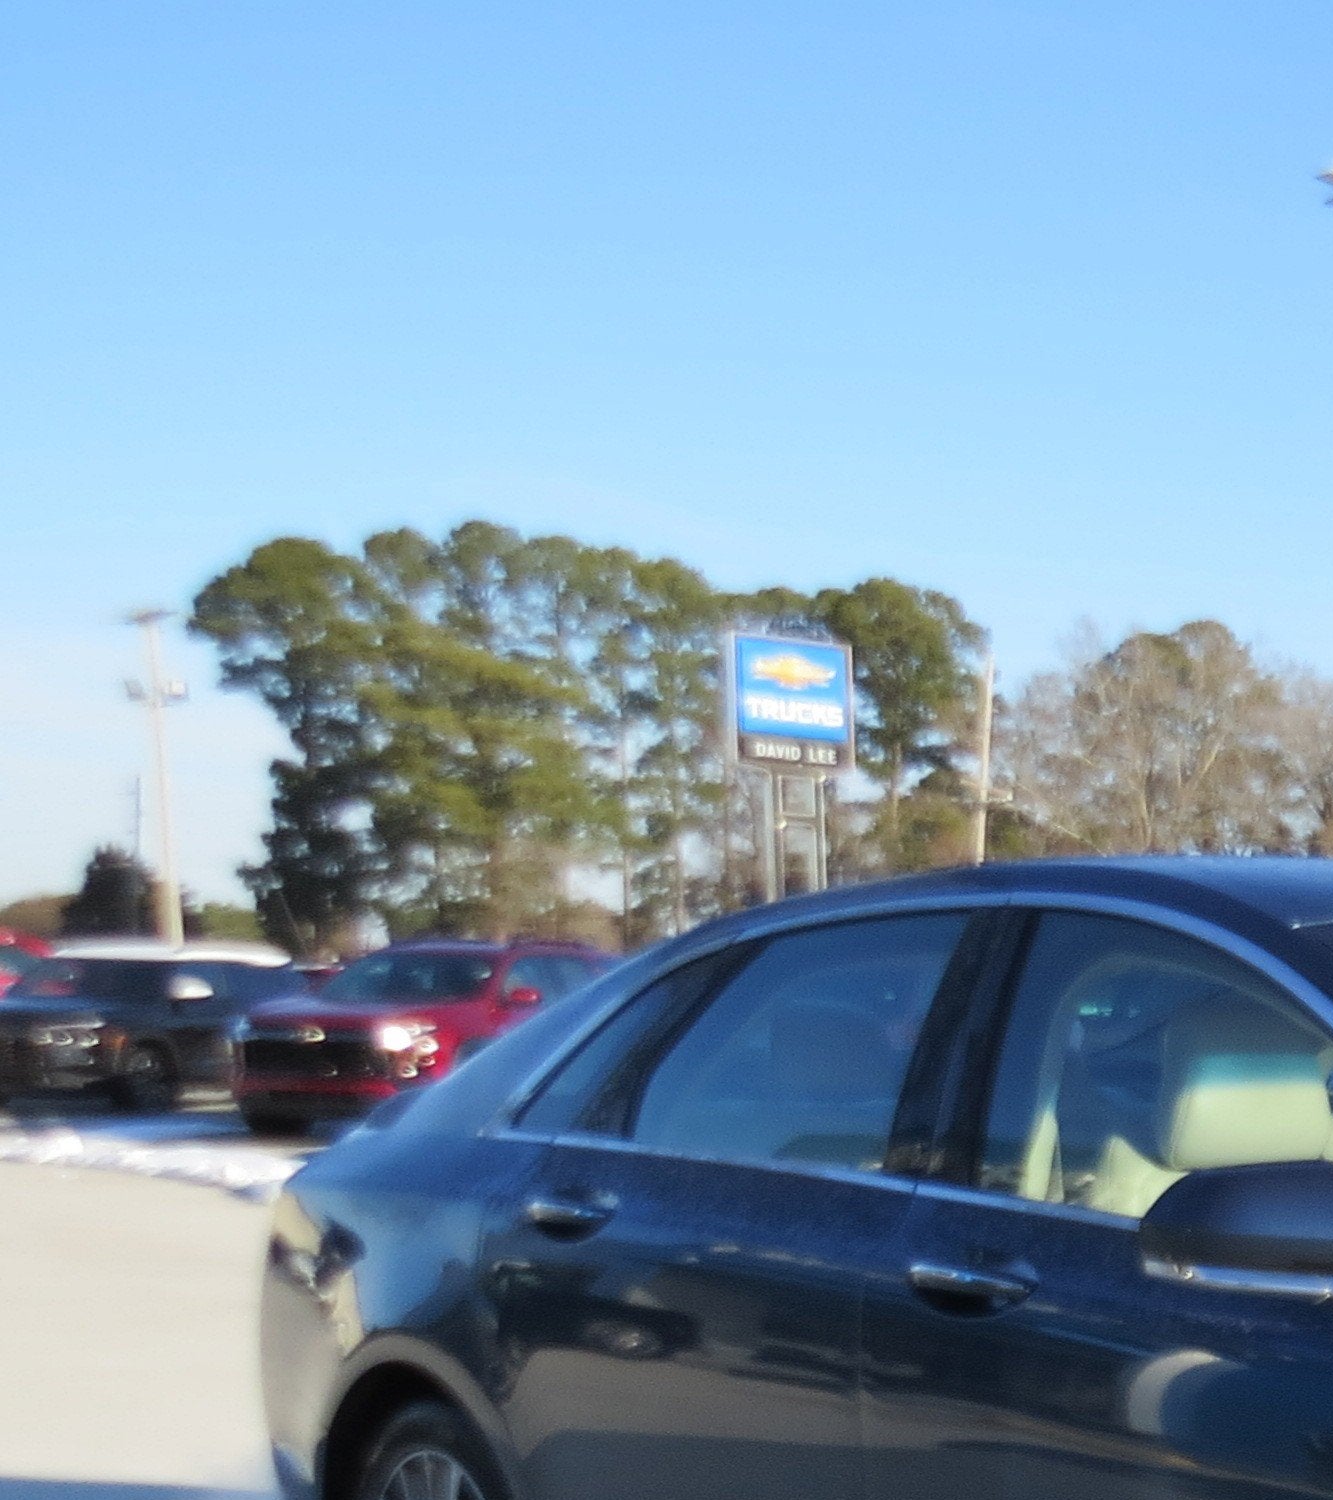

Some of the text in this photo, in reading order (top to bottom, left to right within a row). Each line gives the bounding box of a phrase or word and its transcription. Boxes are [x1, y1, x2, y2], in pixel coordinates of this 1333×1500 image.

[744, 694, 844, 727] TRUCKS
[754, 741, 837, 765] DAVID LEE
